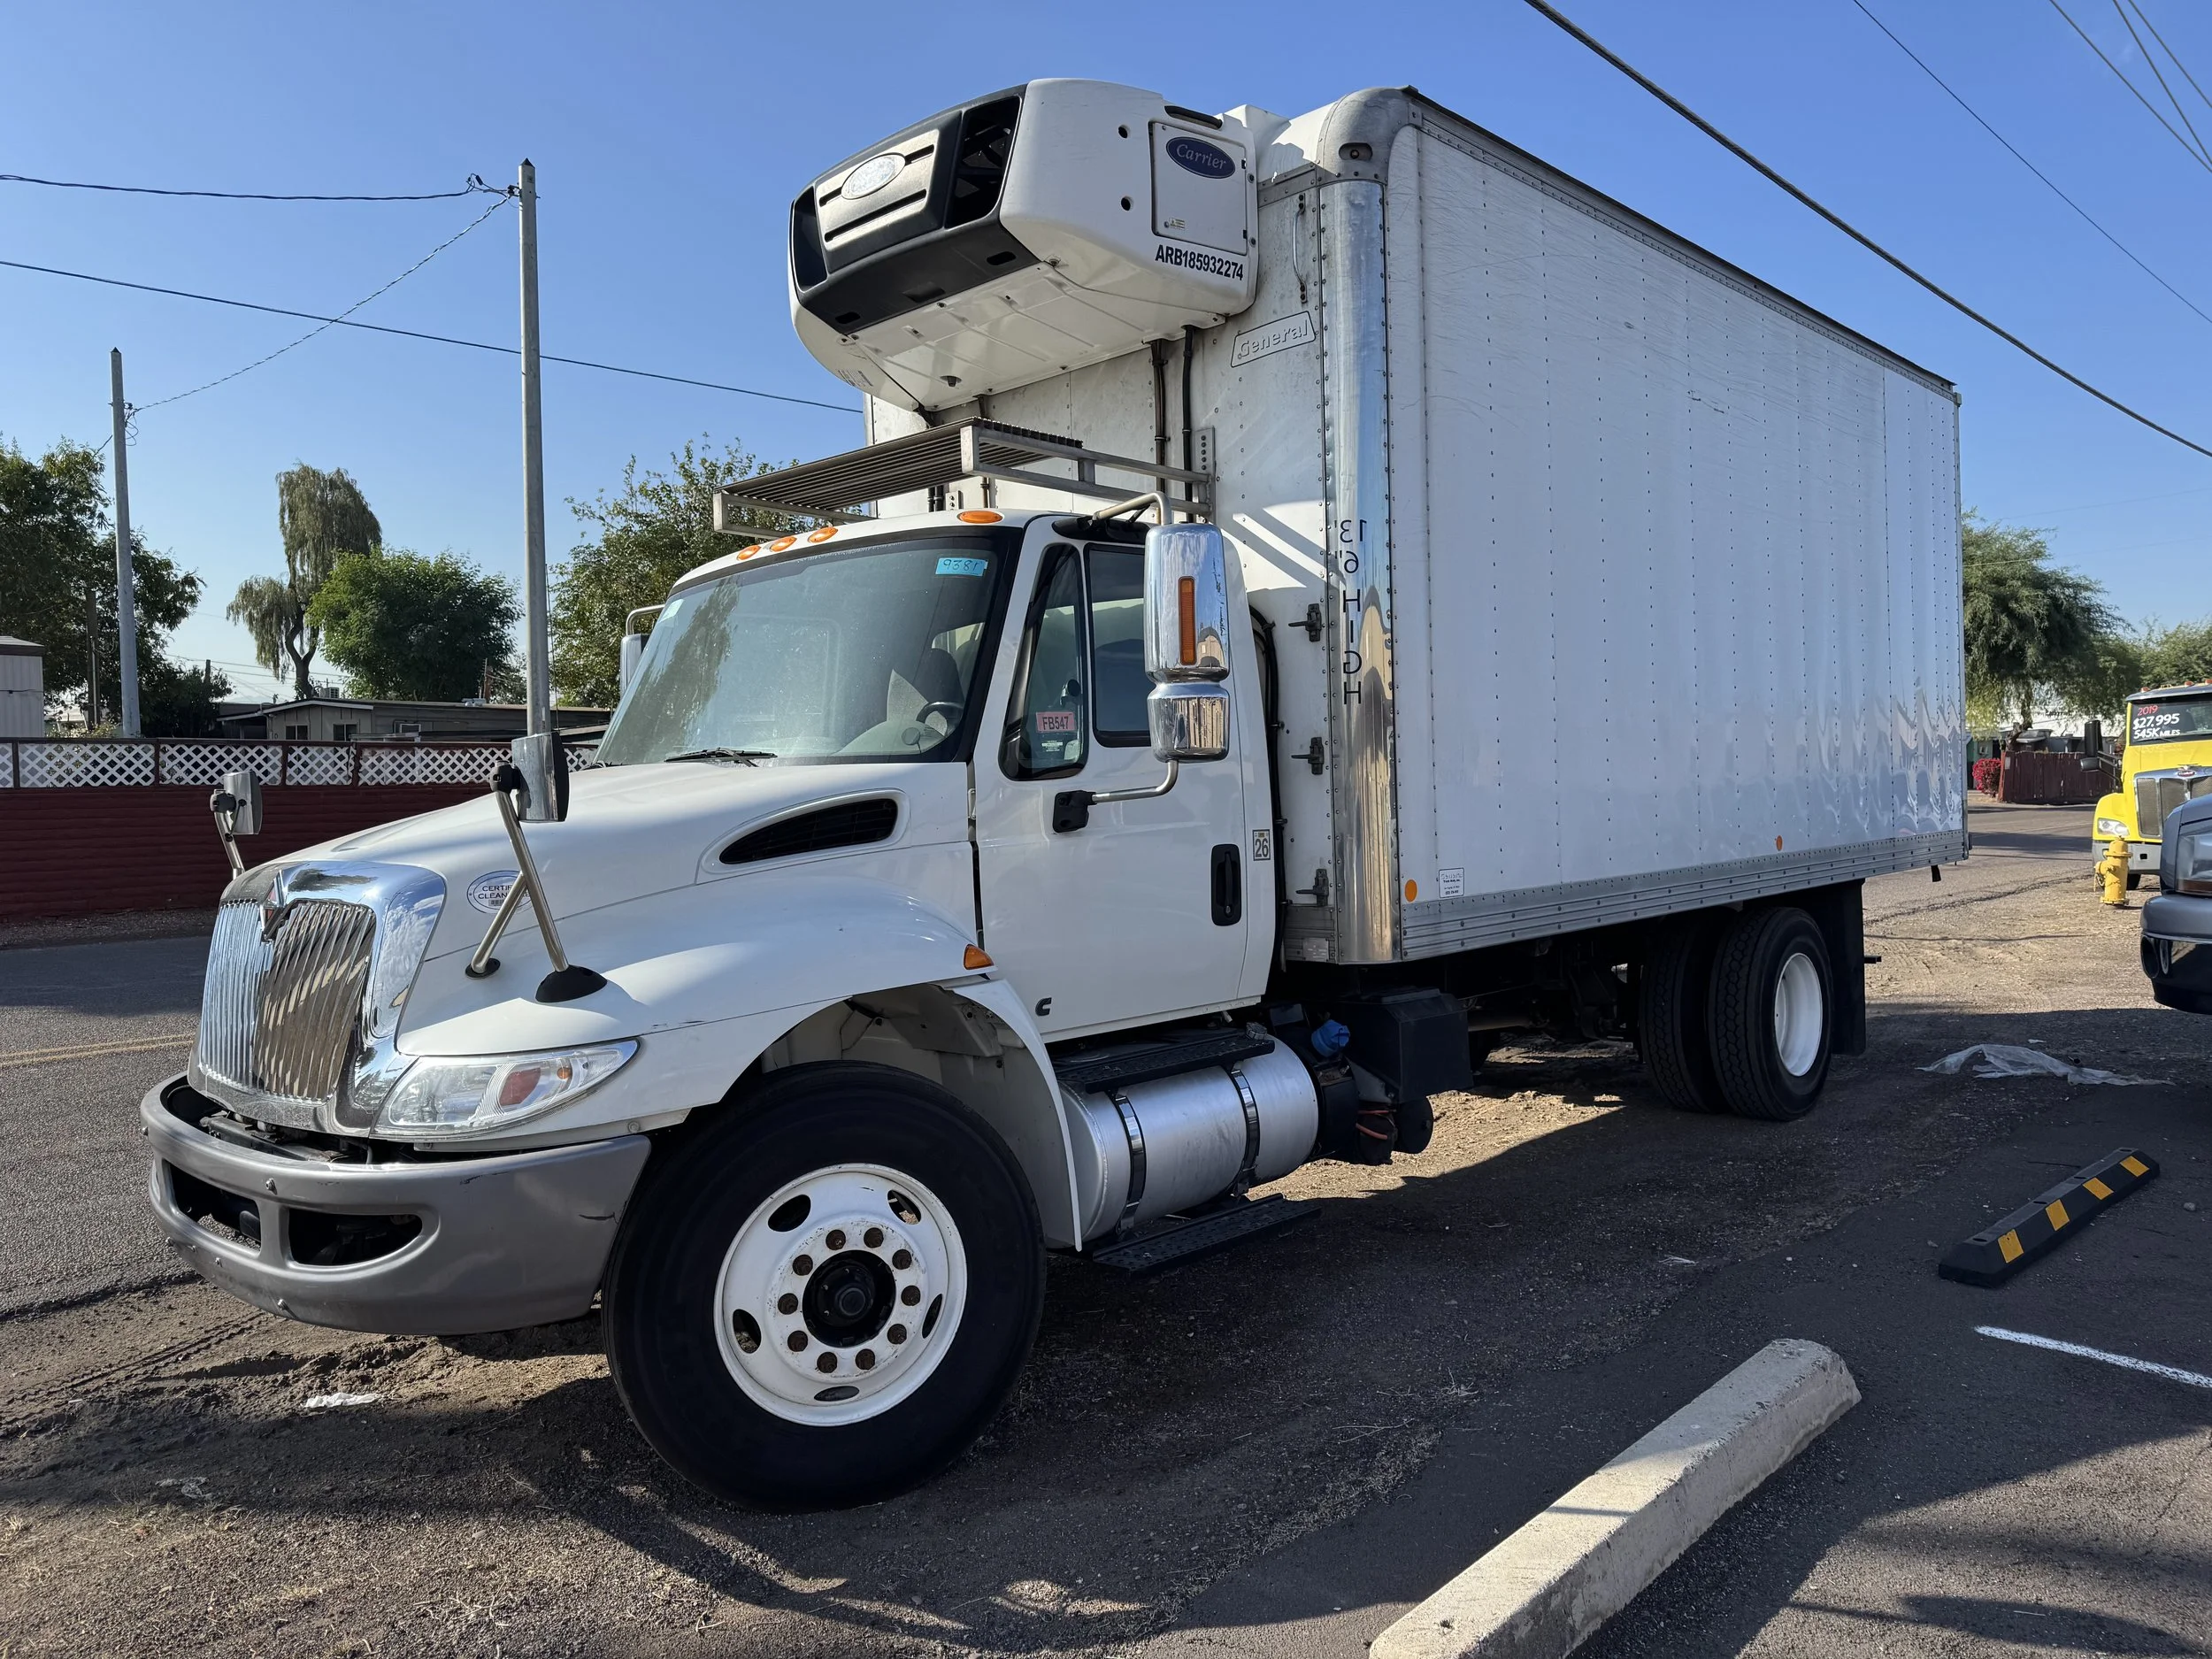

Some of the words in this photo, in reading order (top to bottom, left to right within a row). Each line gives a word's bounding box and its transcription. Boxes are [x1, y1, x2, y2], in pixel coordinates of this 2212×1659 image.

[1176, 144, 1227, 171] Carrier
[1155, 244, 1244, 280] ARB185932274
[1239, 319, 1309, 357] General
[2138, 705, 2158, 716] 2019
[1042, 716, 1069, 730] FB547
[2133, 727, 2160, 739] 545K
[1256, 838, 1269, 857] 26
